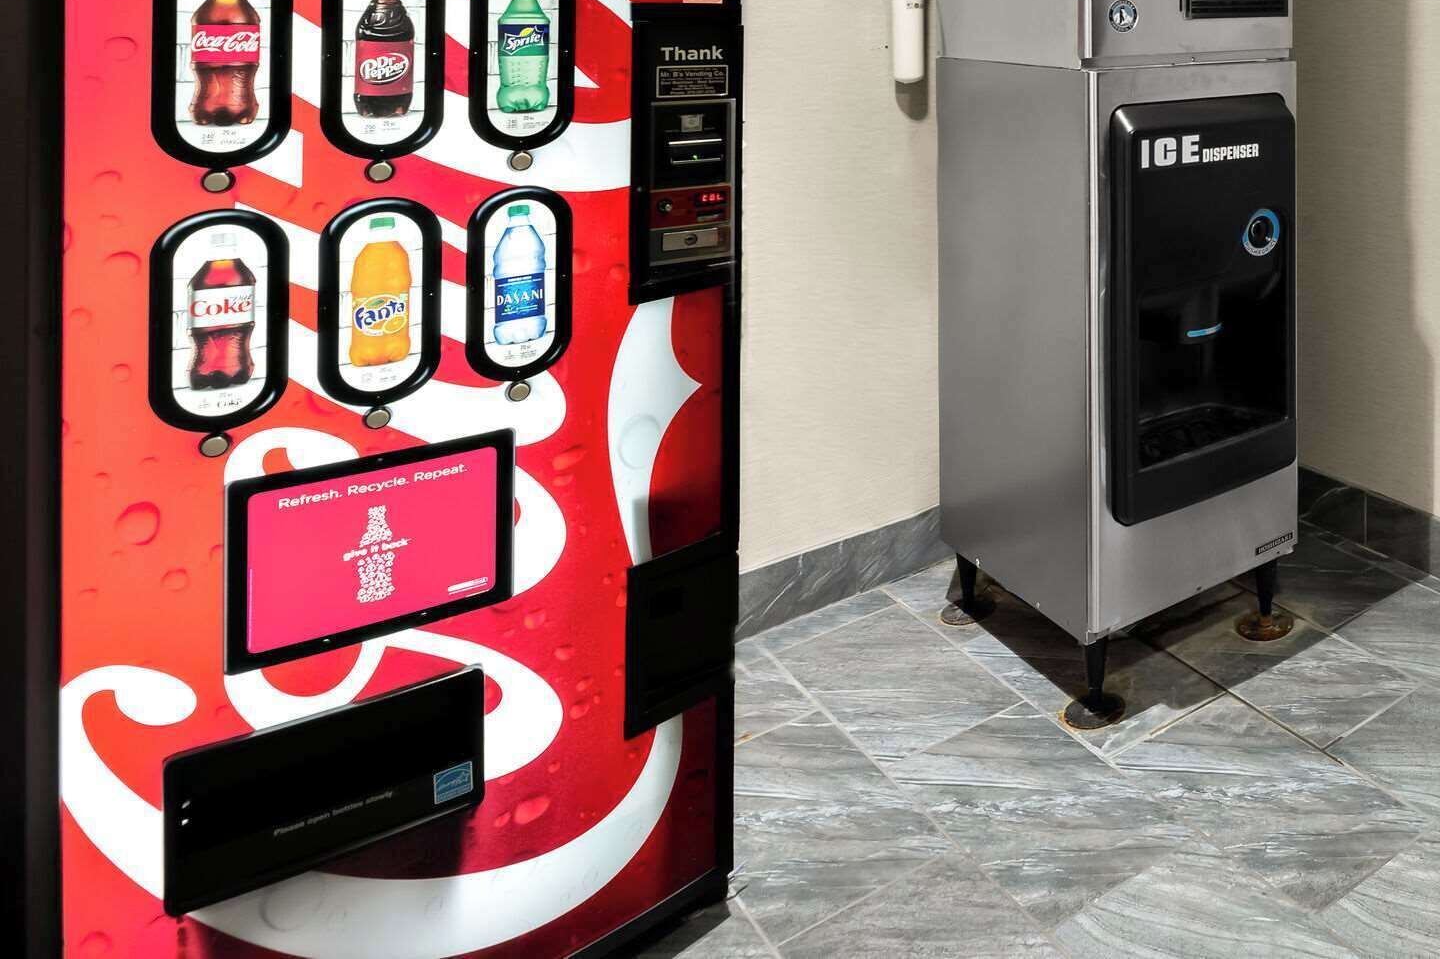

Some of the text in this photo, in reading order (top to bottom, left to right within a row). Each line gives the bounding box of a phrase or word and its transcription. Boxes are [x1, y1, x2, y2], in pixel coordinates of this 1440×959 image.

[192, 30, 260, 52] Coca-Cola
[505, 32, 541, 51] Sprite
[376, 56, 397, 69] Dr
[660, 45, 724, 61] Thank
[362, 58, 406, 80] Pepper
[1141, 134, 1260, 169] ICE DISPENSER
[496, 288, 543, 306] DASANI
[190, 299, 252, 318] Coke
[355, 301, 405, 330] Fanta
[277, 462, 468, 510] Refresh. Recycle. Repeat.
[343, 537, 409, 561] give it back
